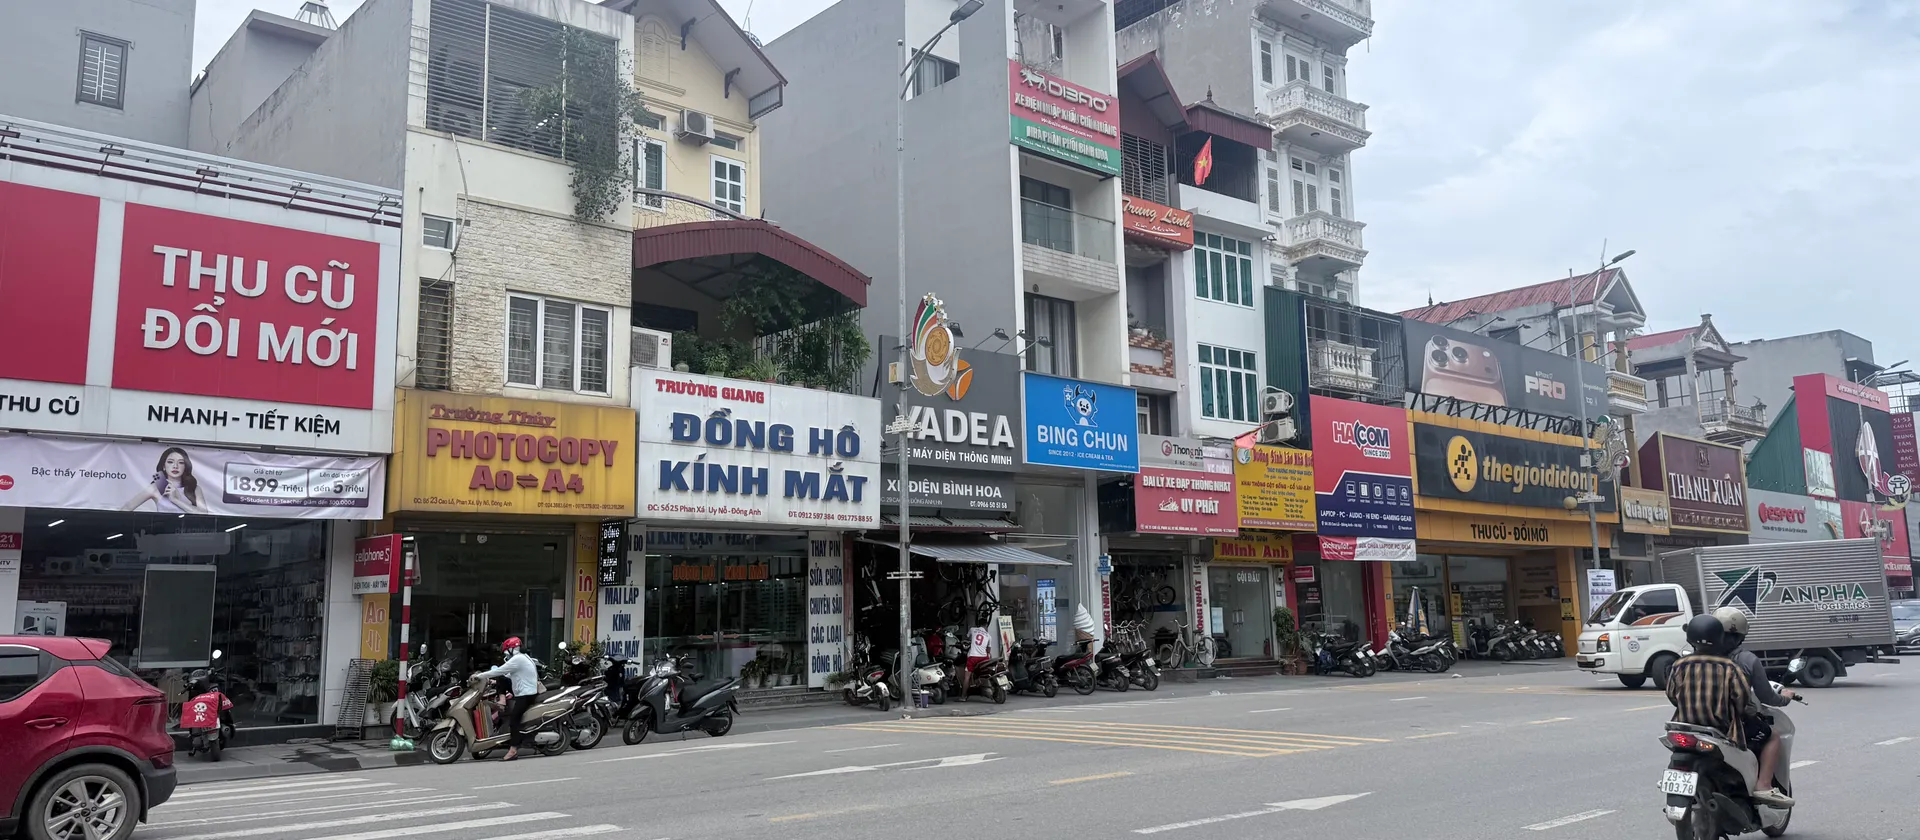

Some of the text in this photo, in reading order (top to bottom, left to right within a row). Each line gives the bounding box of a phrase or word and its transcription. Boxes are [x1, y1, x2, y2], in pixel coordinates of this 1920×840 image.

[1015, 92, 1025, 106] XE
[1122, 196, 1157, 223] Trung
[1160, 208, 1191, 229] Linh
[153, 245, 355, 309] THU CŨ
[141, 296, 358, 370] ĐỔI MỚI
[656, 378, 765, 404] TRƯỜNG GIANG
[1525, 375, 1565, 400] PRO
[0, 395, 80, 416] THU CŨ
[430, 403, 504, 426] Trường
[147, 404, 341, 437] NHANH TIẾT KIỆM
[669, 407, 794, 453] ĐỒNG
[1037, 424, 1128, 452] BING CHUN
[1333, 420, 1390, 449] HACOM
[427, 427, 618, 467] PHOTOCOPY
[912, 446, 1012, 466] MÁY ĐIỆN THÔNG MINH
[1048, 448, 1062, 457] SINCE
[1062, 450, 1075, 458] 2012
[1363, 449, 1391, 459] SINCE 2001
[31, 466, 127, 480] Bậc Telephoto
[542, 468, 584, 493] A4
[658, 453, 868, 503] KÍNH MẮT
[230, 476, 304, 493] 18.99 Triệu
[314, 480, 364, 494] đến 5 Triệu
[908, 478, 1002, 499] ĐIỆN BÌNH HOA
[1166, 477, 1175, 488] XE
[1176, 478, 1190, 491] ĐẠP
[1669, 472, 1743, 507] THANH XUÂN
[430, 496, 439, 504] 23
[647, 504, 660, 512] ĐC:
[679, 505, 696, 513] Phan
[708, 508, 717, 516] Uy
[1181, 497, 1219, 514] UY PHÁT
[1320, 510, 1336, 518] LAPTOP
[1624, 499, 1653, 524] Quảng
[0, 534, 13, 543] 21
[1471, 521, 1549, 542] THU CŨ ĐỔI MỚI
[811, 540, 841, 557] THAY PIN
[1221, 542, 1289, 558] Minh Anh
[579, 568, 593, 593] in
[810, 562, 843, 586] SỬA CHỮA
[624, 580, 639, 605] LẮP
[1780, 583, 1868, 604] ANPHA
[810, 593, 843, 615] CHUYÊN SÂU
[1814, 601, 1870, 611] LOGISTICS
[612, 610, 631, 631] KÍNH
[811, 622, 842, 646] CÁC LOẠI
[975, 633, 984, 646] 9
[624, 636, 640, 658] MÁY
[811, 647, 842, 674] ĐỒNG HỒ
[1664, 782, 1693, 794] 103.78
[1668, 772, 1692, 783] 29-S2
